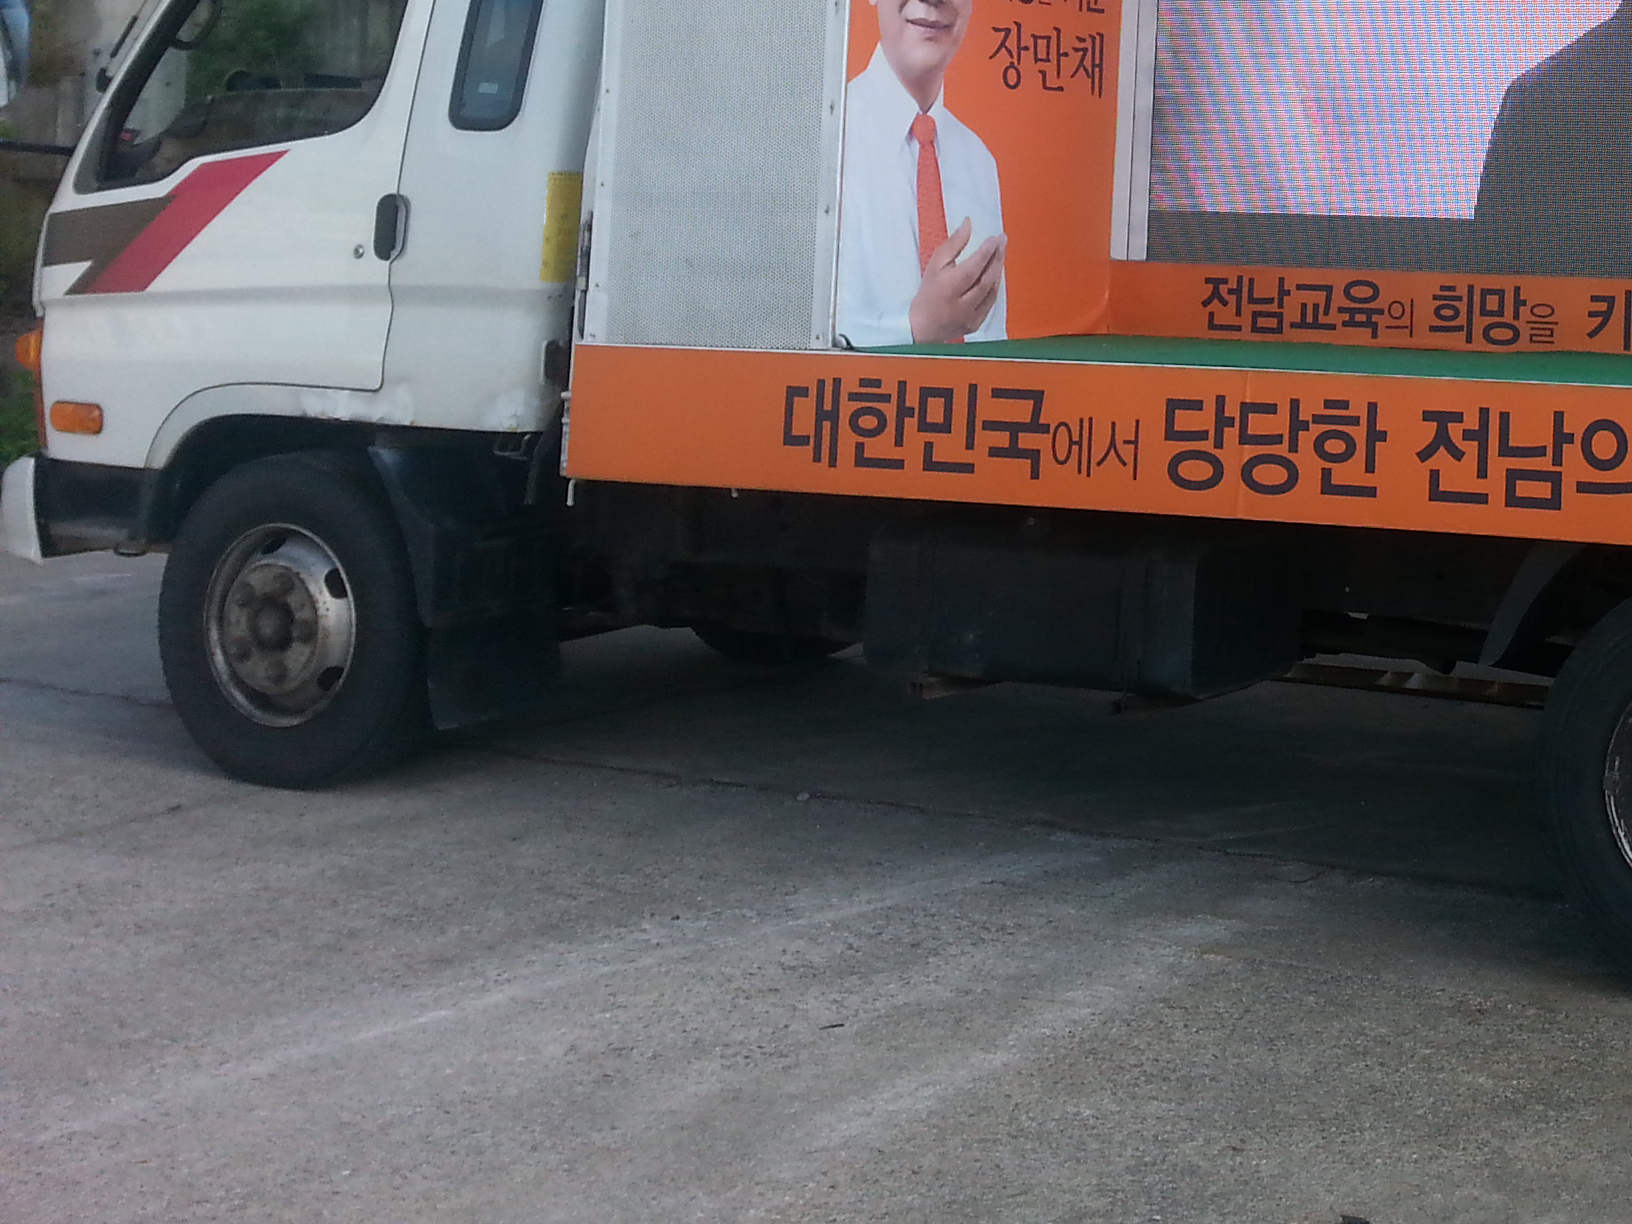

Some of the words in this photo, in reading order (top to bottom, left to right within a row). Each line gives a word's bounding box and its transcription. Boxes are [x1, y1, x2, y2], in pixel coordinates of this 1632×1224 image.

[988, 20, 1105, 99] 장만채
[1200, 275, 1415, 341] 전남교육의
[1428, 284, 1559, 347] 희망을
[782, 377, 1141, 482] 대한민국에서
[1163, 392, 1388, 499] 당당한
